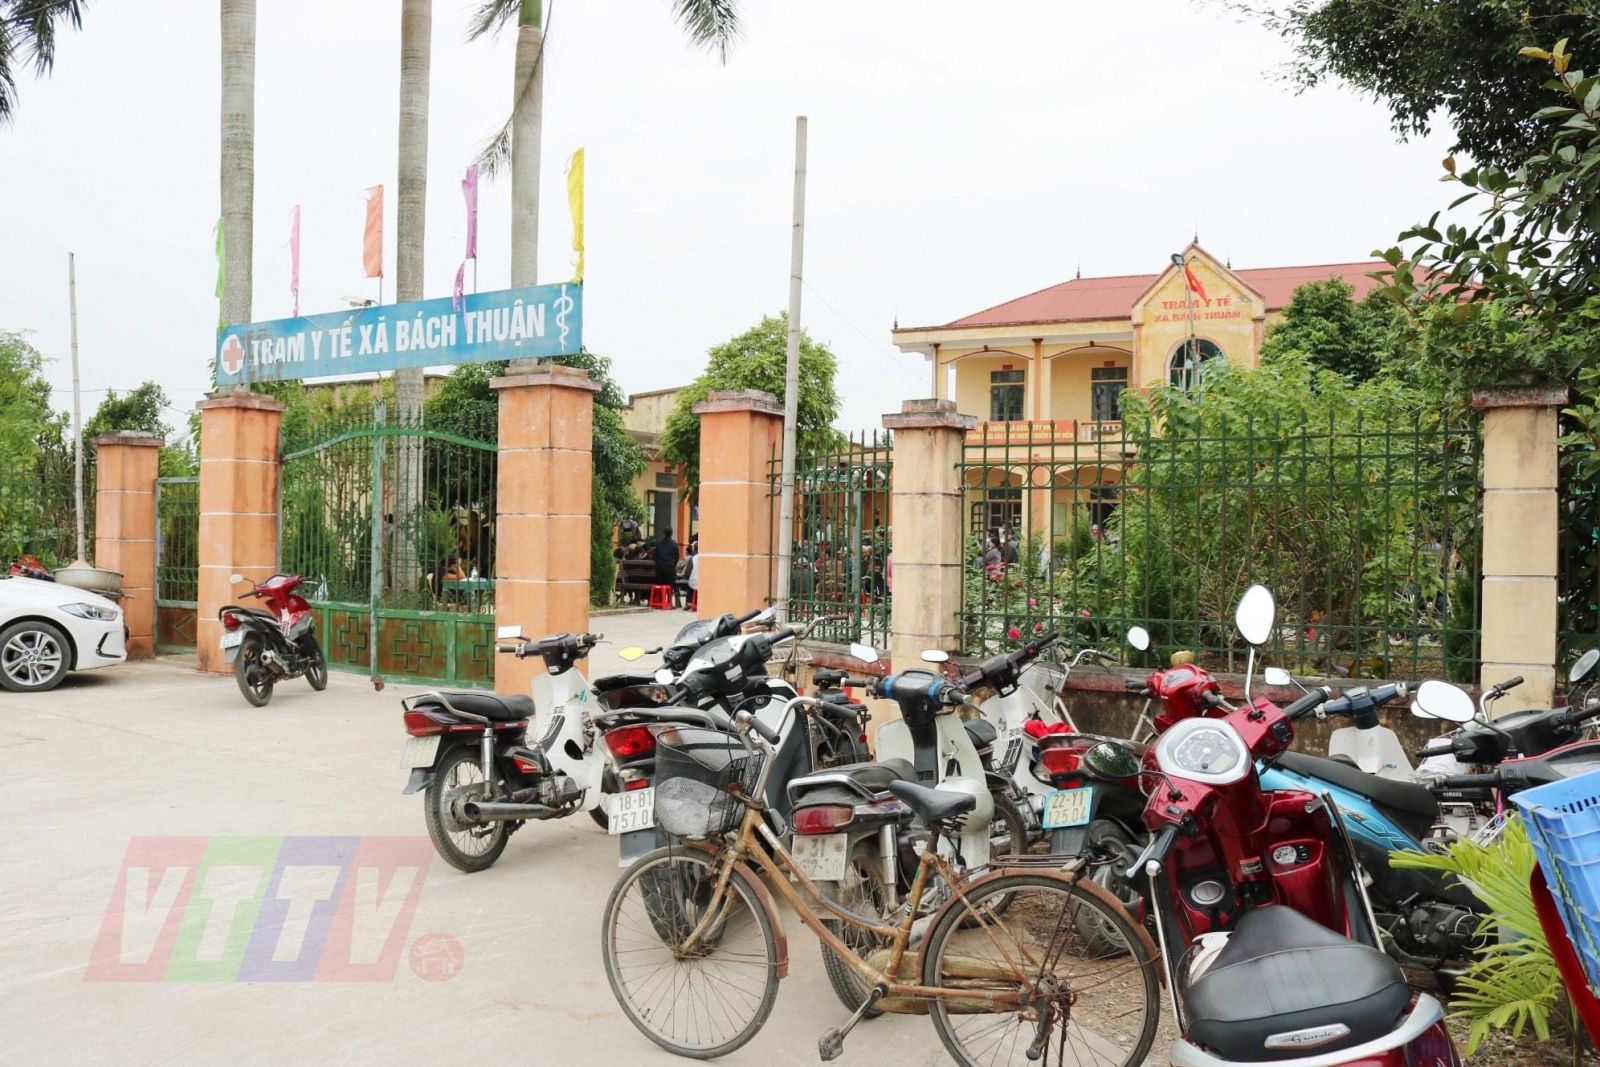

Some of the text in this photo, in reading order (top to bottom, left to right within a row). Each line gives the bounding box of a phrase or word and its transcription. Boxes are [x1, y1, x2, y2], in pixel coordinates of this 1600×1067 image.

[311, 330, 323, 360] Y
[329, 315, 354, 358] TẾ
[396, 311, 457, 352] BÁCH
[464, 299, 545, 347] THUẬN
[619, 790, 652, 811] 18-B1
[1051, 791, 1085, 809] 22-Y1
[613, 809, 650, 832] 757.0
